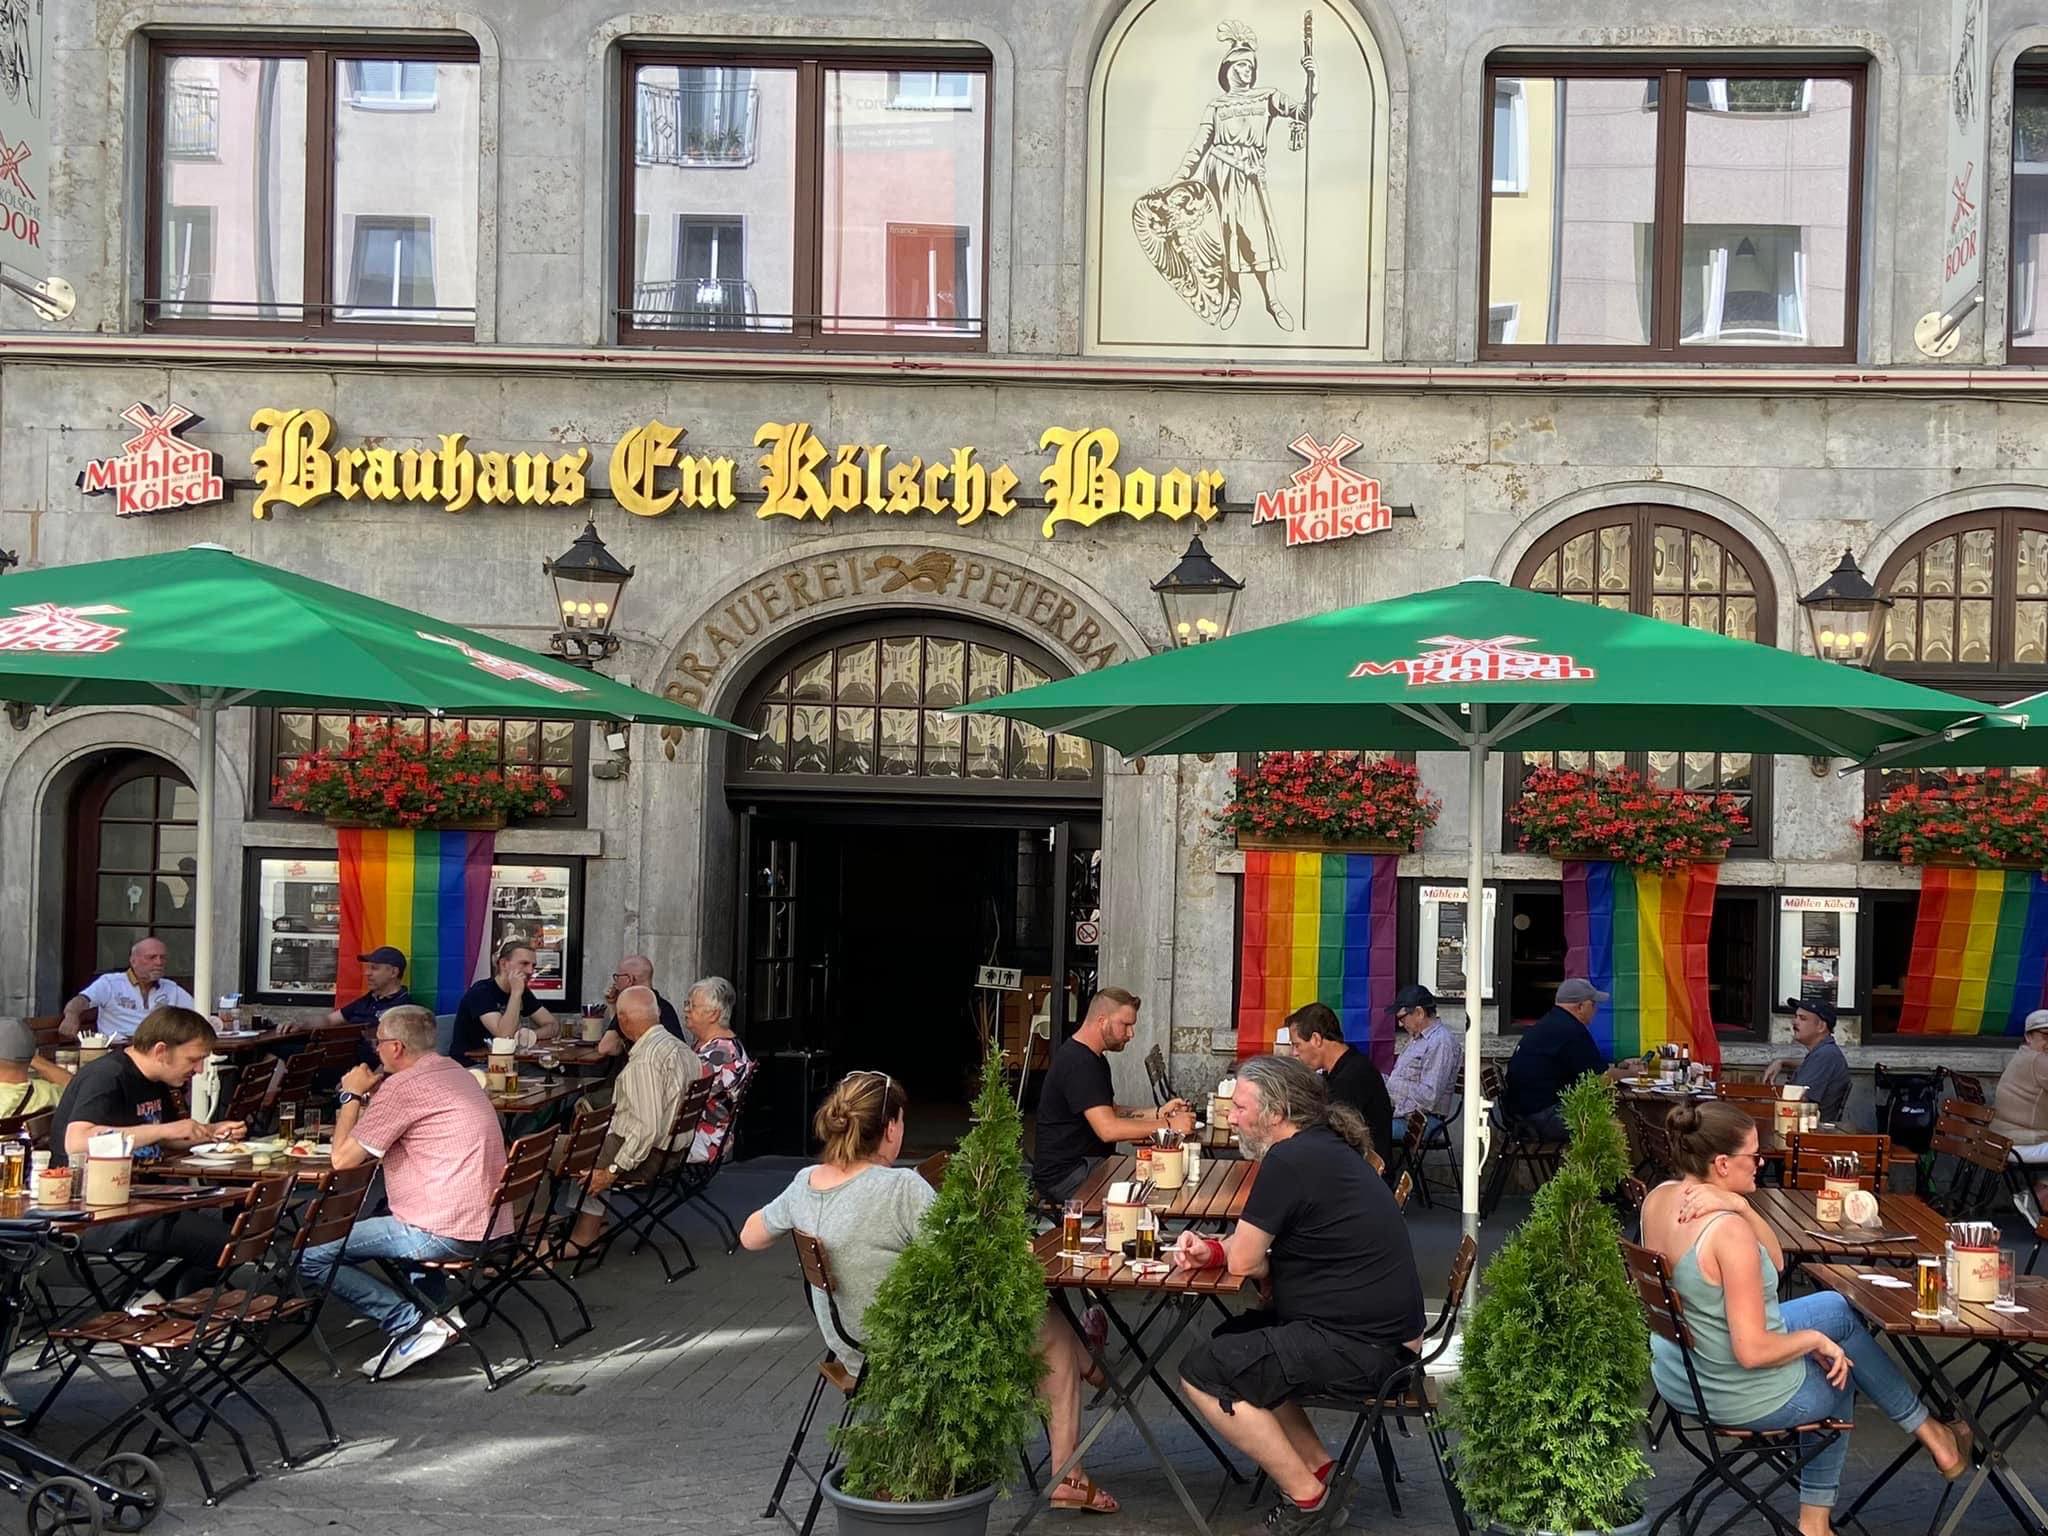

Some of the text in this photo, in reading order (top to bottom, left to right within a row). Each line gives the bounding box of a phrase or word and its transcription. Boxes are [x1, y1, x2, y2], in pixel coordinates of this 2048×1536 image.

[0, 203, 40, 249] OOR
[1945, 229, 1977, 283] BOOR
[86, 449, 210, 490] Mühlen
[250, 407, 1227, 538] Brauhaus Em Kölsche Boor
[118, 471, 221, 513] Kölsch
[1255, 479, 1379, 521] Mühlen
[1288, 501, 1390, 544] Kölsch
[663, 556, 864, 710] BRAUEREI
[956, 559, 1120, 670] PETERBA
[1354, 653, 1571, 676] Mühlen
[1411, 665, 1592, 684] Kölsch
[1423, 889, 1460, 899] Mühlen
[1784, 897, 1822, 908] Mühlen
